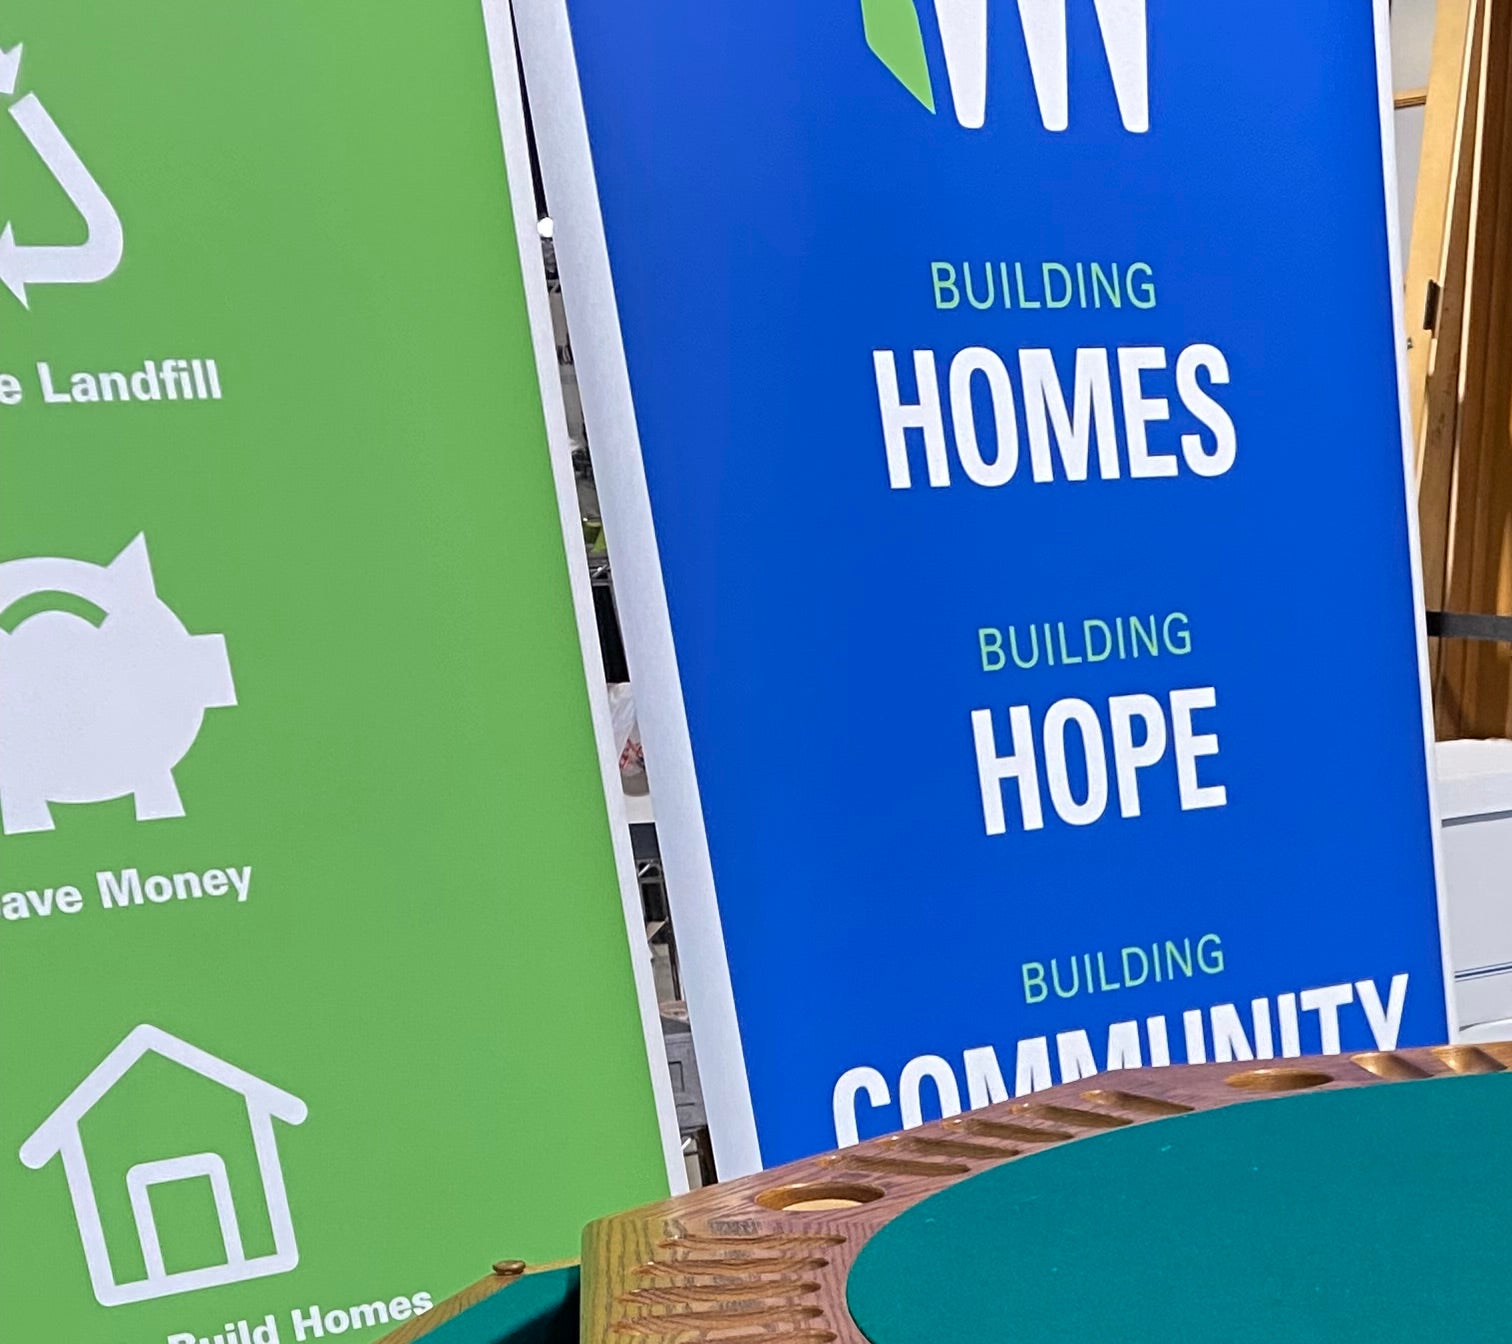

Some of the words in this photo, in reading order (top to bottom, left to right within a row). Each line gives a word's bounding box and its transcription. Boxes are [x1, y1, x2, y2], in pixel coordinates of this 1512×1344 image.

[931, 261, 1157, 310] BUILDING
[36, 358, 222, 404] Landfill
[873, 343, 1238, 490] HOMES
[978, 612, 1193, 672] BUILDING
[970, 686, 1228, 836] HOPE
[0, 885, 84, 922] ave
[96, 866, 253, 910] Money
[1022, 933, 1225, 1005] BUILDING
[290, 1290, 434, 1342] Homes
